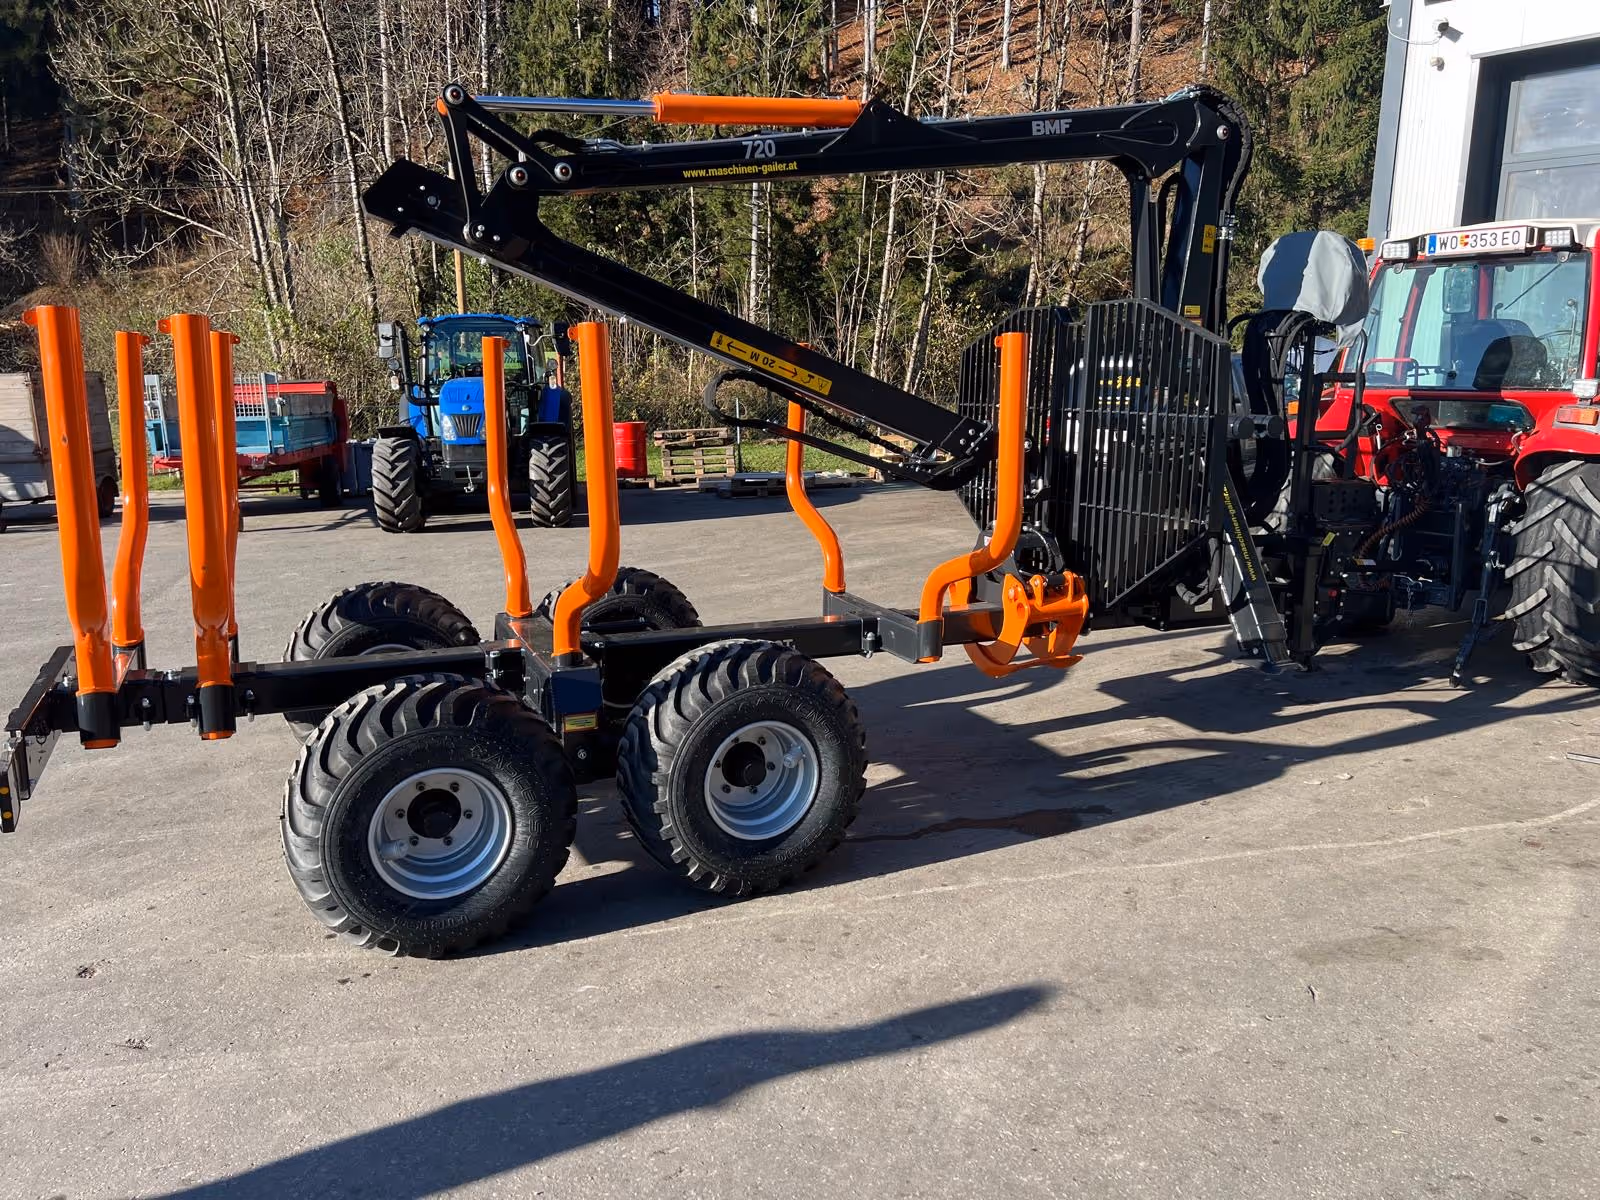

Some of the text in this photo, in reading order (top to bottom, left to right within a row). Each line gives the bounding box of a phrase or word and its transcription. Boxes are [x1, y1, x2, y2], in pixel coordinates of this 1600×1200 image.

[1031, 118, 1072, 137] BMF
[741, 138, 776, 160] 720
[682, 160, 798, 179] www.maschinen-gailer.at
[1439, 235, 1458, 250] WO
[1469, 233, 1498, 248] 353
[750, 351, 776, 368] 20 M
